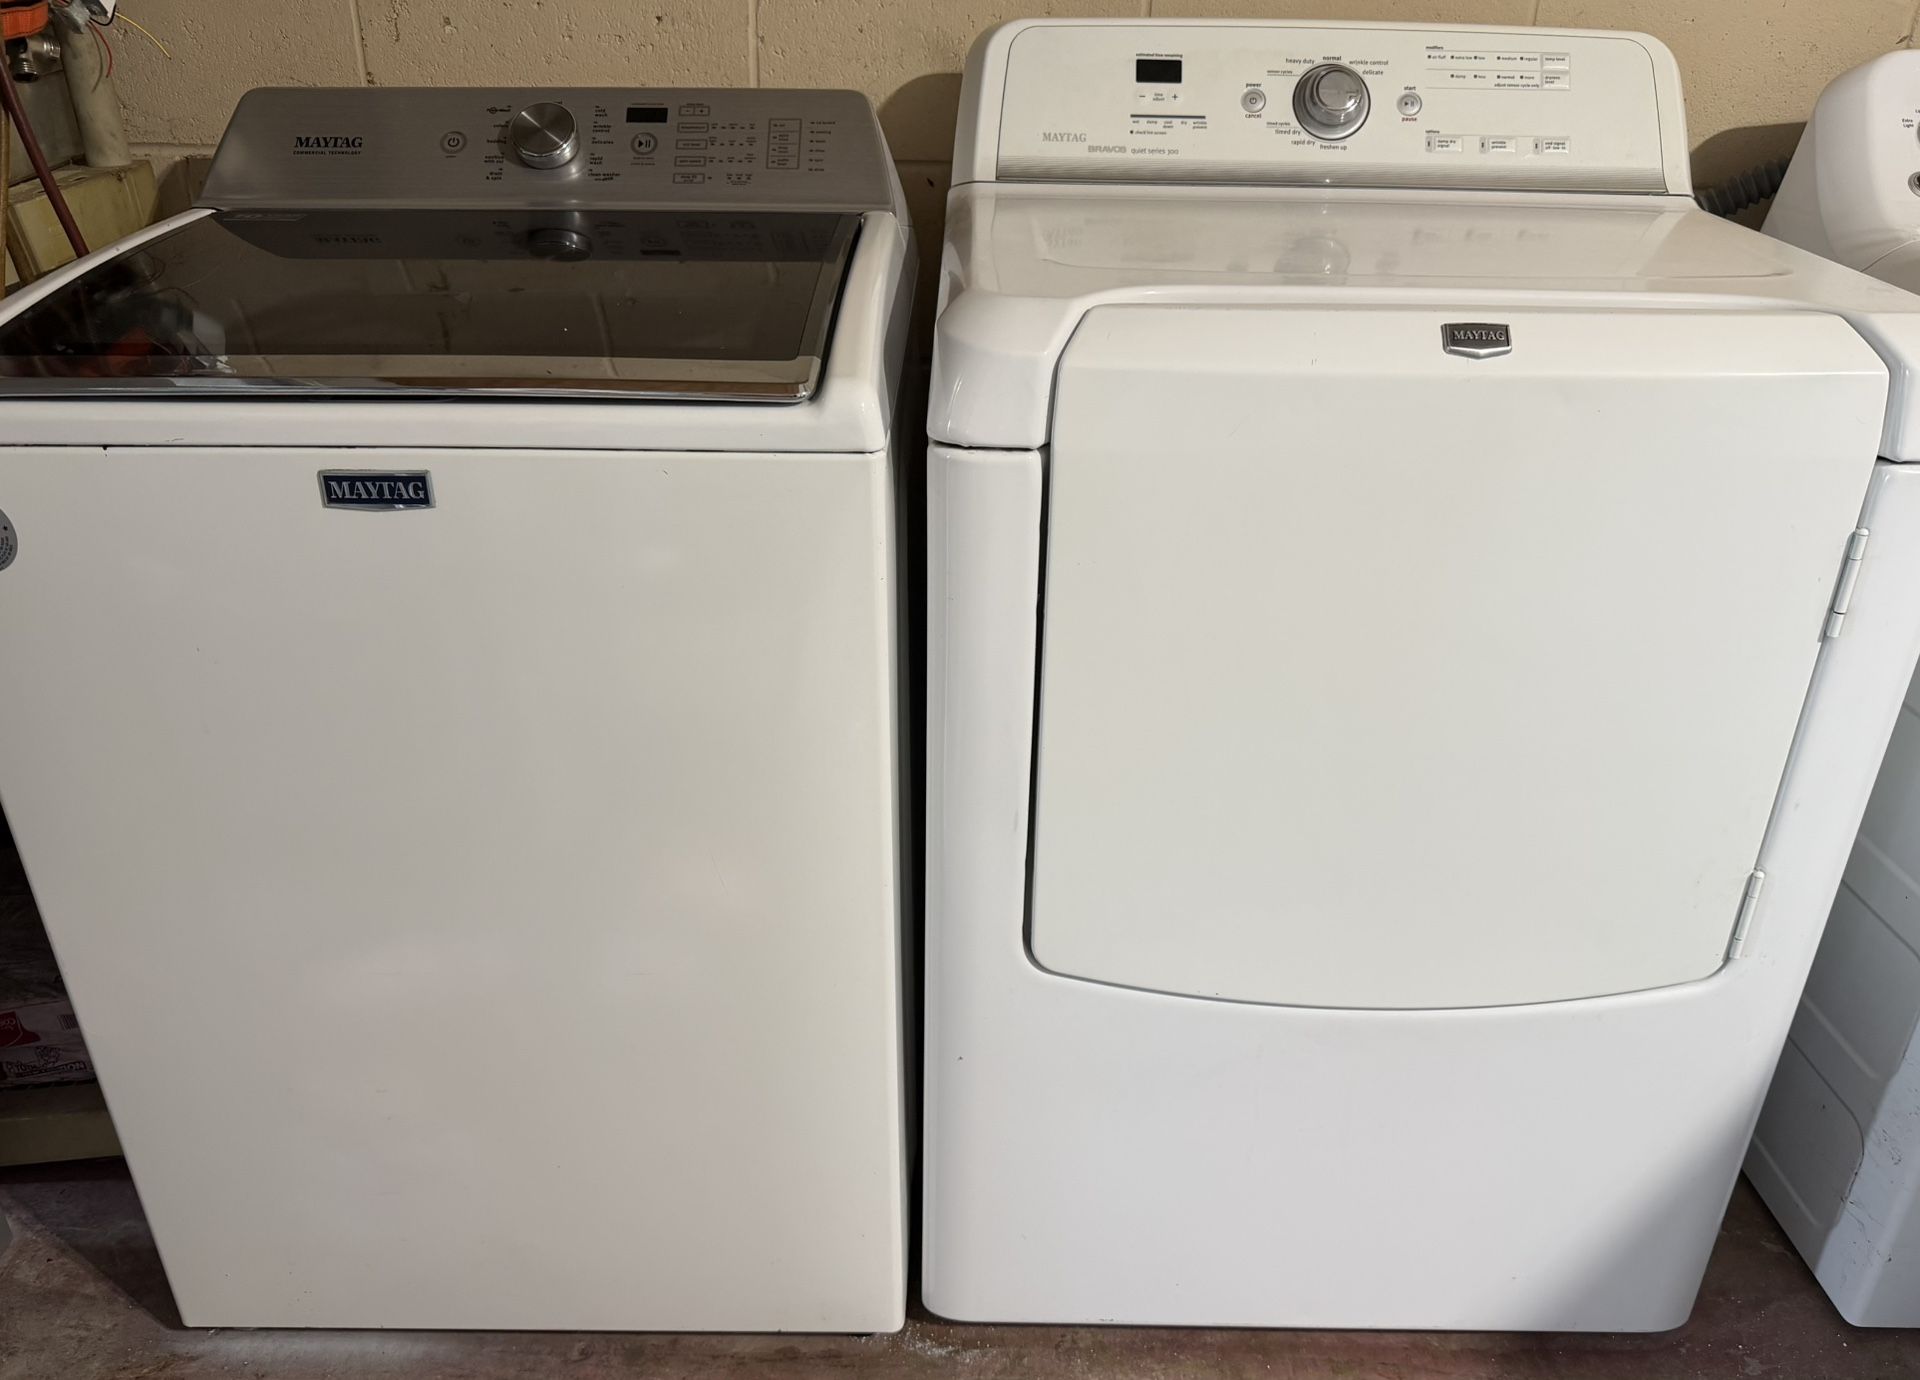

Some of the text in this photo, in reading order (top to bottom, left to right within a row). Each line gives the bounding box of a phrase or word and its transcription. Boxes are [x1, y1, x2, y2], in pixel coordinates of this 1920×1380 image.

[1285, 58, 1315, 66] heavy duty
[293, 136, 363, 148] MAYTAG
[1042, 132, 1087, 143] MAYTAG
[1088, 145, 1127, 153] BRAVOS
[1131, 147, 1147, 155] quiet
[1453, 330, 1505, 340] MAYTAG
[328, 481, 425, 498] MAYTAG
